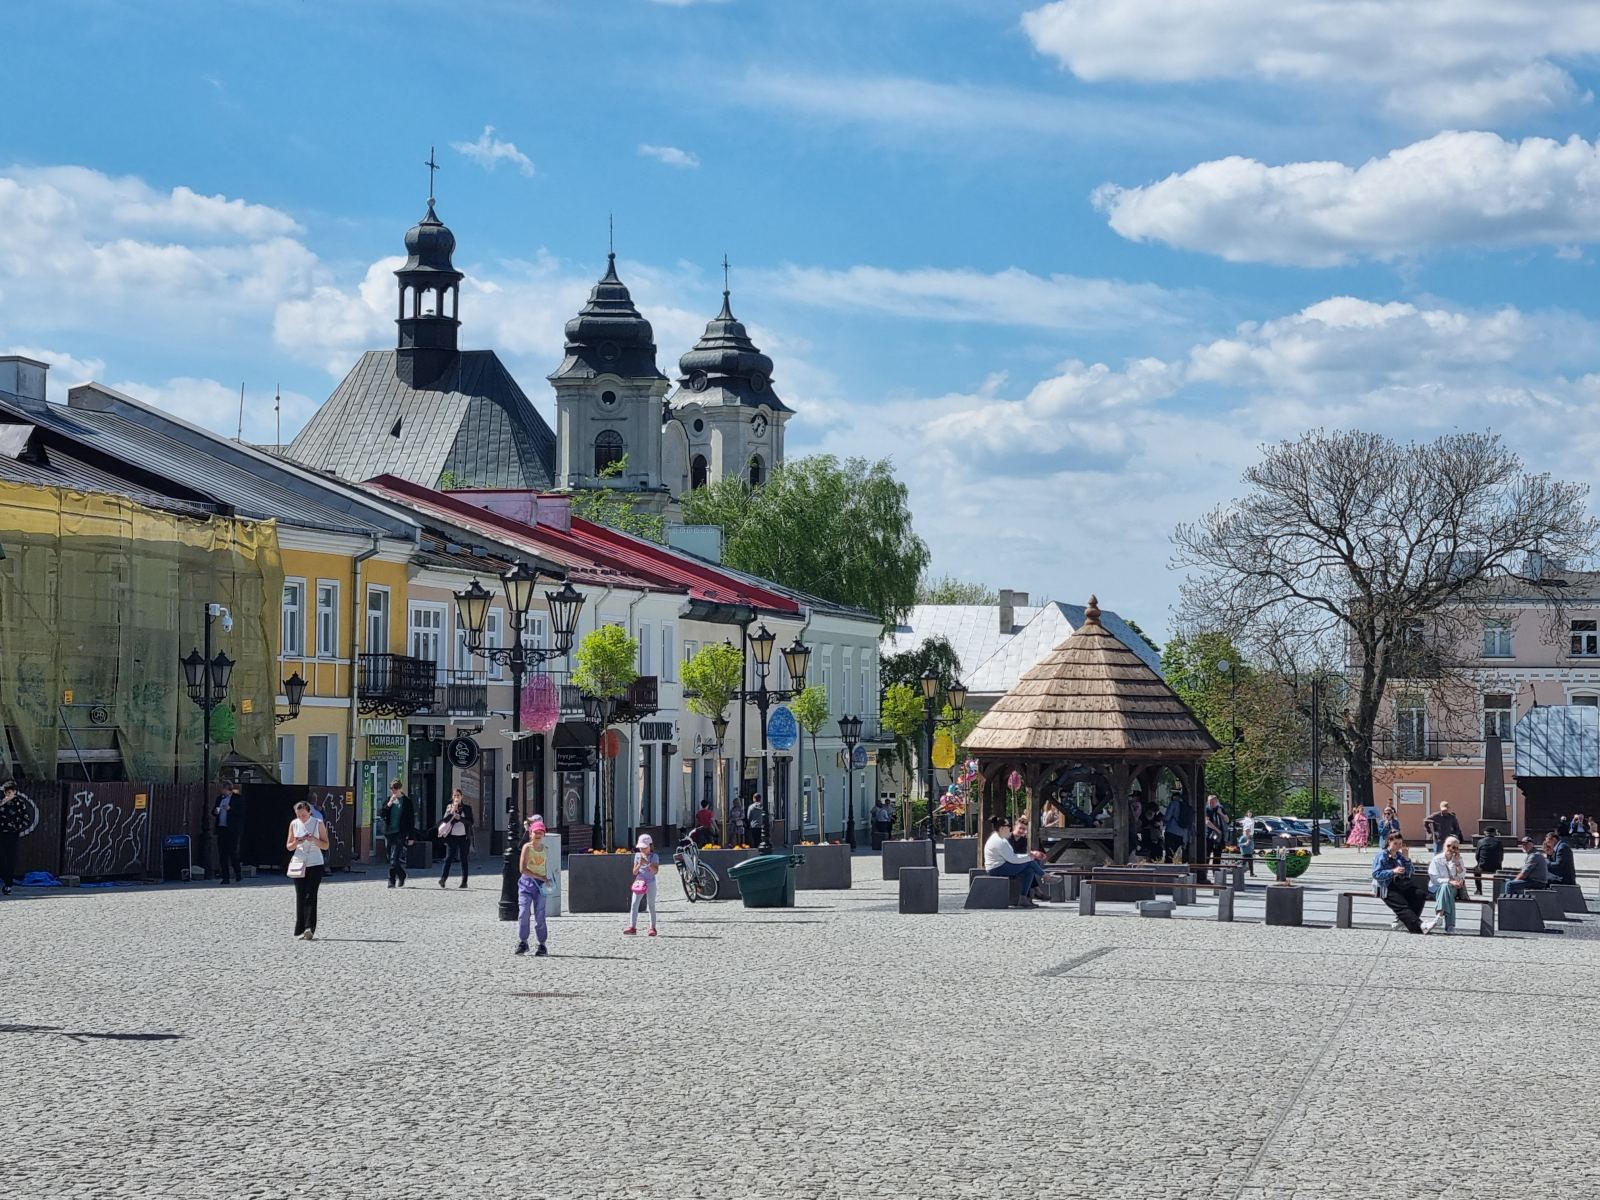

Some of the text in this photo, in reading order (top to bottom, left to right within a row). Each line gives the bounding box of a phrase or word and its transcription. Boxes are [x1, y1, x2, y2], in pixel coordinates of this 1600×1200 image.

[360, 719, 402, 735] LOMBARD
[639, 722, 674, 742] OBUWIE
[370, 736, 404, 746] LOMBARD
